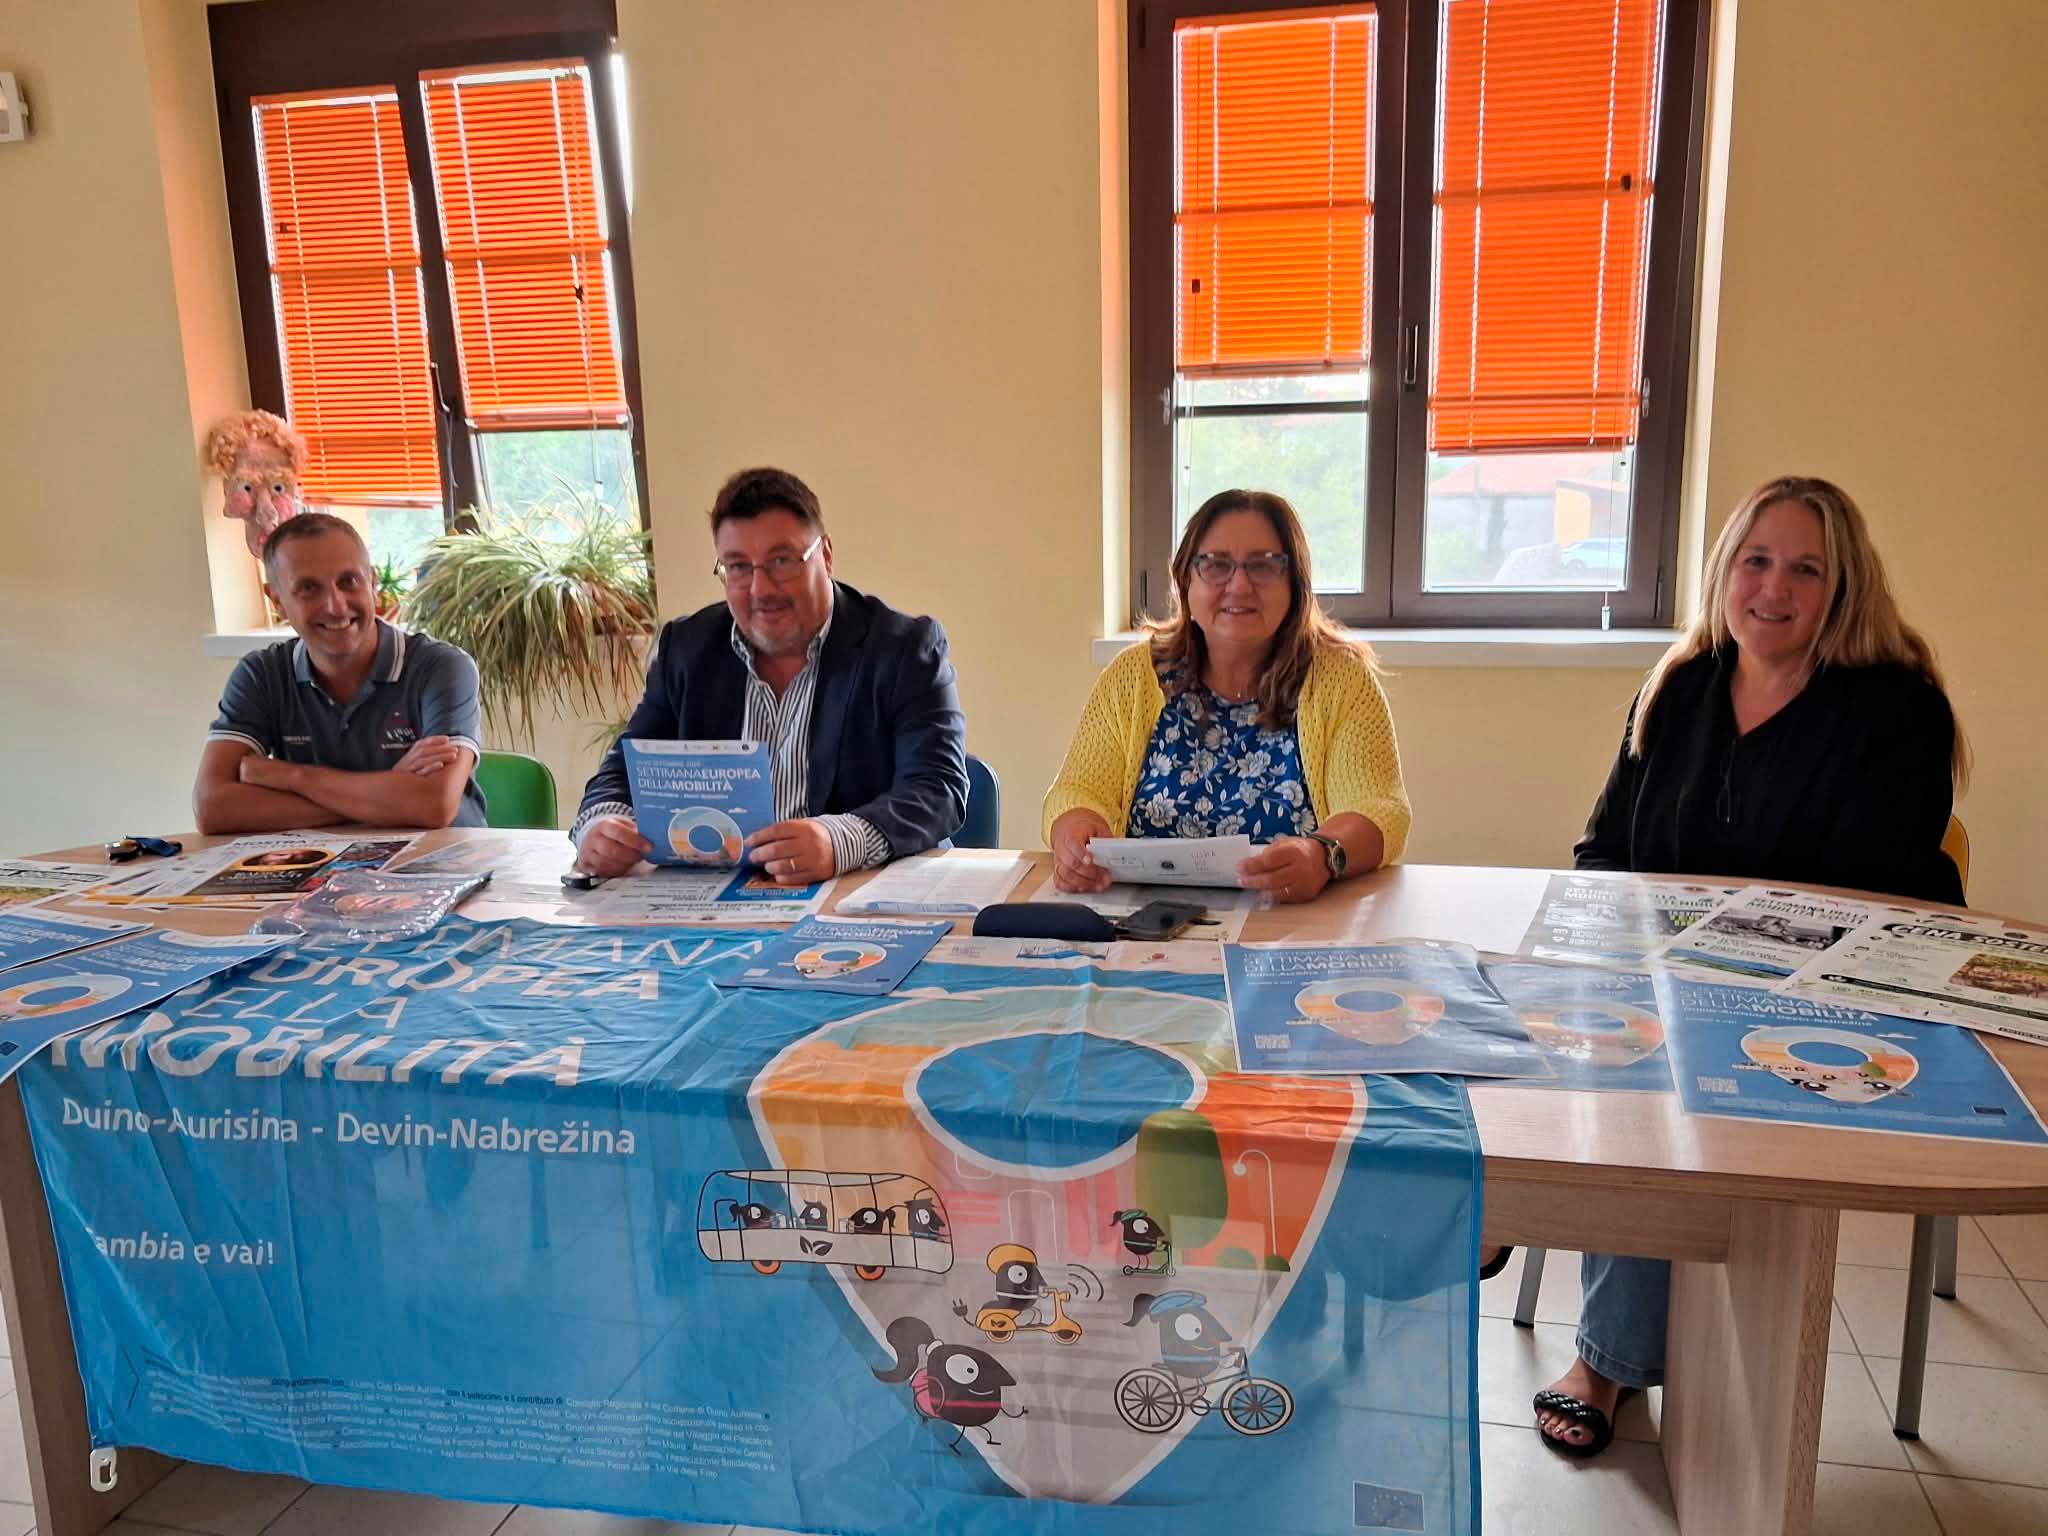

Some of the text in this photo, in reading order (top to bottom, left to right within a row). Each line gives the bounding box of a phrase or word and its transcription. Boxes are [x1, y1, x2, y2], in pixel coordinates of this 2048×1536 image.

[62, 1097, 298, 1143] Duino-Aurisina
[336, 1111, 636, 1155] Devin-Nabrežina
[94, 1231, 274, 1266] ambia e vai!
